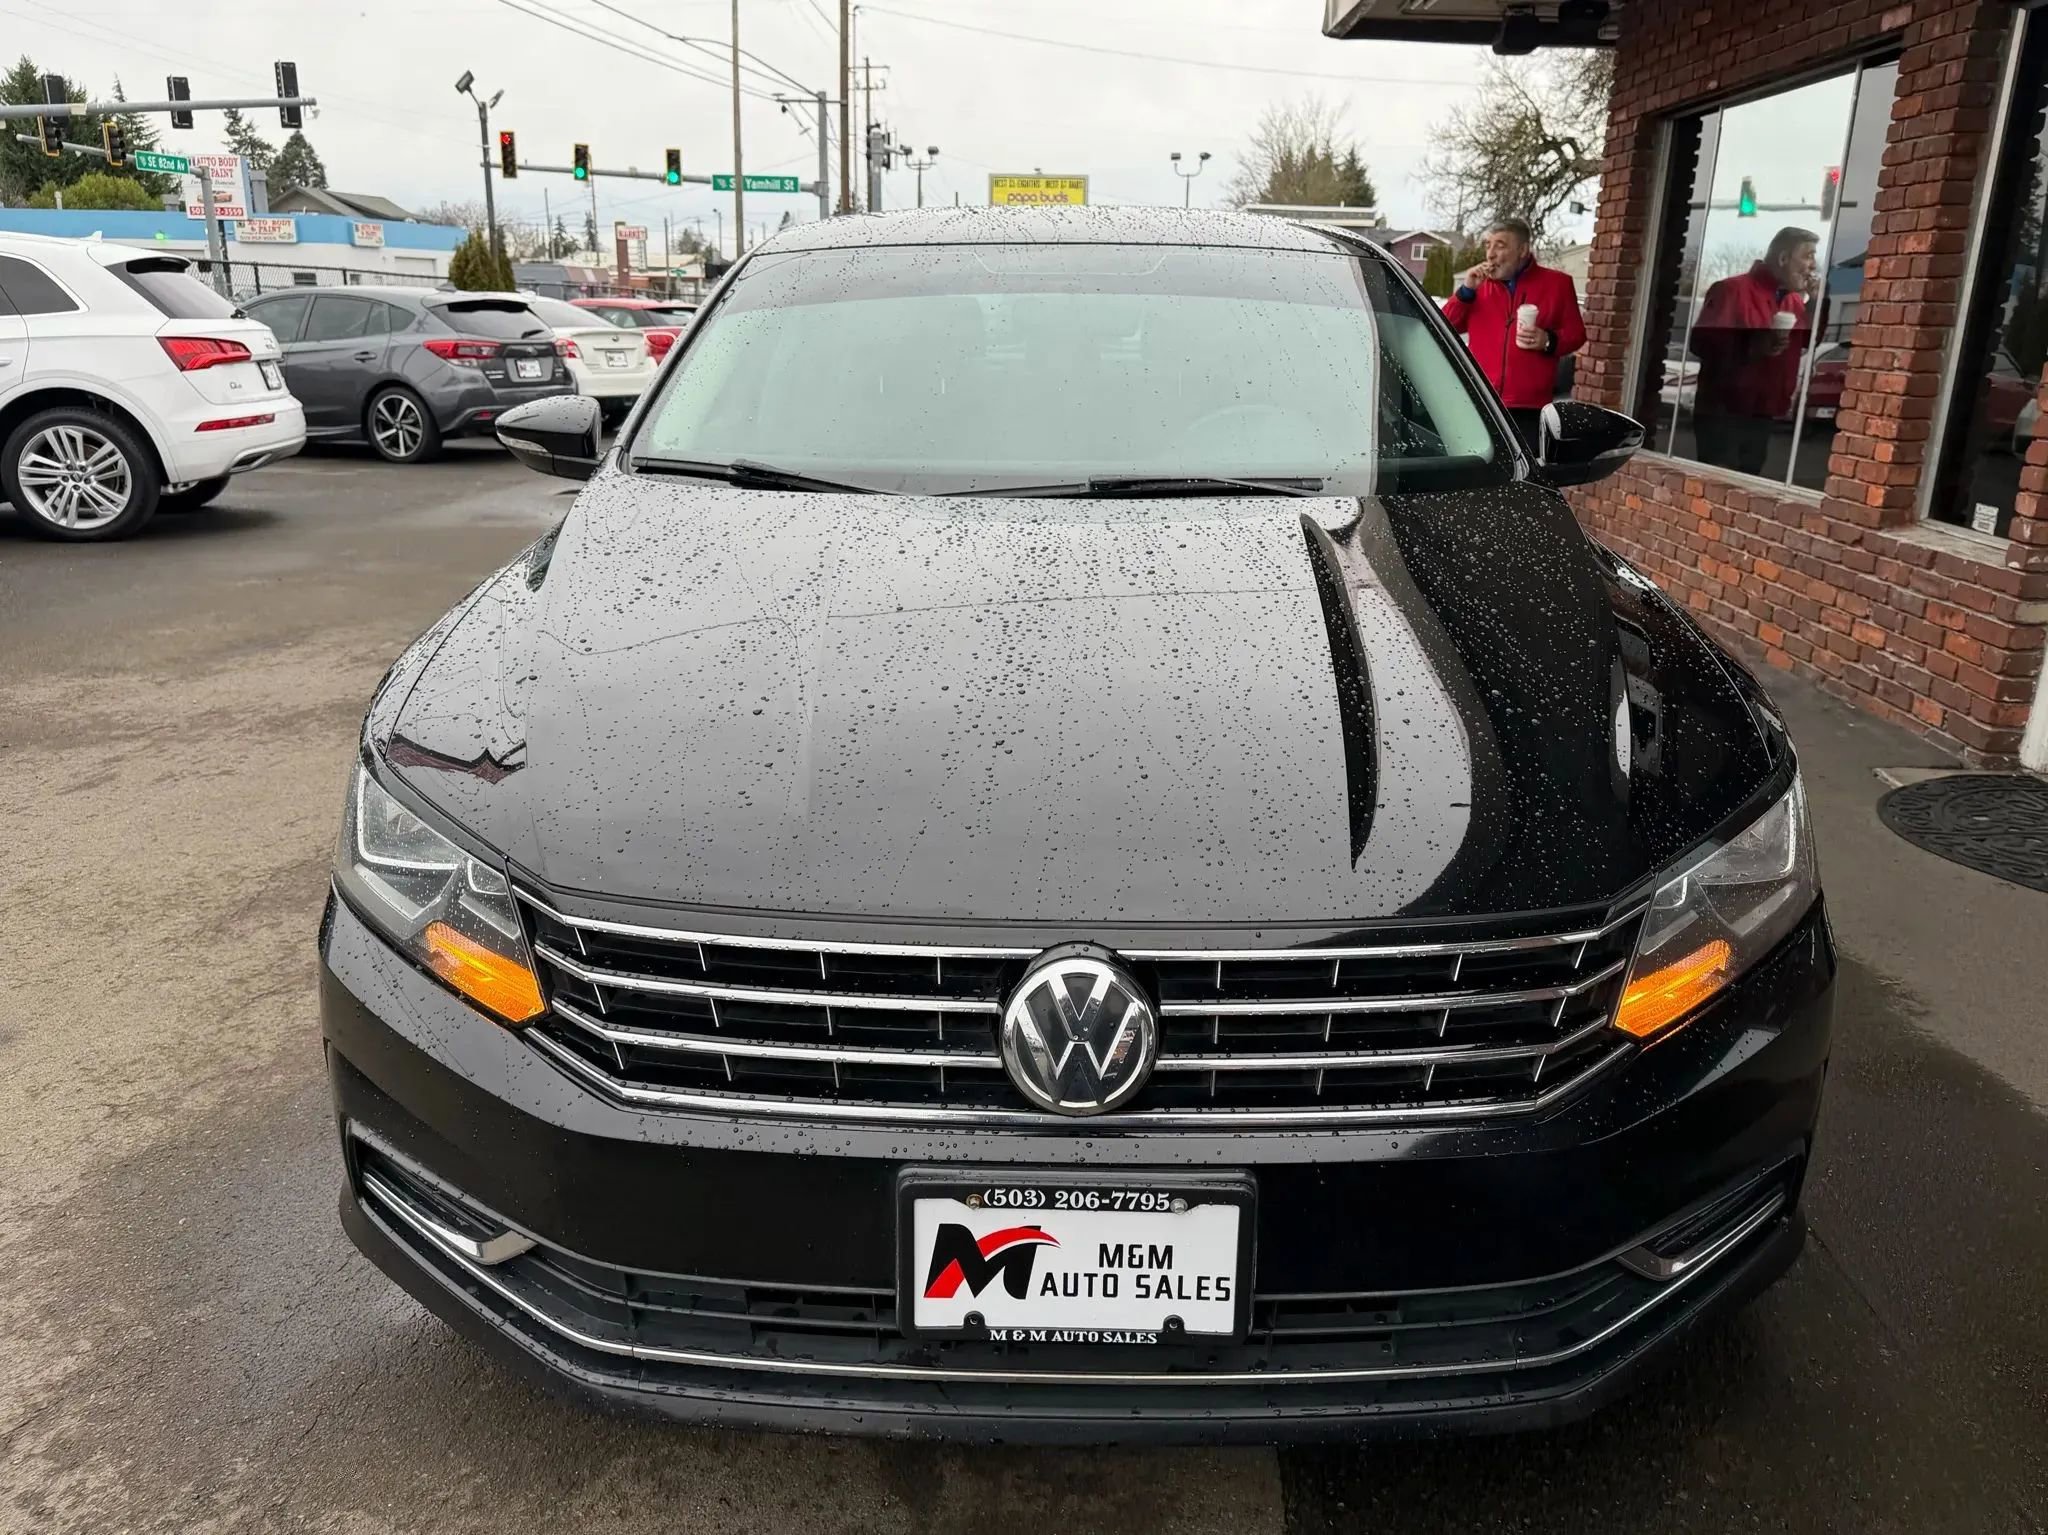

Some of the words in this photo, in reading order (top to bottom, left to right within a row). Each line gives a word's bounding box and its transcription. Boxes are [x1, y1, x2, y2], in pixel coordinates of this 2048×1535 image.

[147, 156, 157, 166] SE
[159, 157, 175, 169] 82nd
[177, 161, 185, 171] Av
[197, 156, 216, 167] AUTO
[218, 156, 239, 167] BODY
[211, 168, 233, 178] PAINT
[744, 177, 780, 190] Yamhill
[783, 179, 795, 191] St
[1007, 192, 1037, 206] papa
[1040, 191, 1069, 202] buds
[983, 1188, 1046, 1209] (503)
[1053, 1190, 1171, 1212] 206-7795
[1098, 1242, 1174, 1270] M&M
[1039, 1272, 1119, 1299] AUTO
[1134, 1274, 1232, 1302] SALES
[989, 1329, 1010, 1342] M
[1012, 1330, 1026, 1342] &
[1029, 1330, 1047, 1342] M
[1051, 1330, 1099, 1344] AUTO
[1102, 1332, 1158, 1345] SALES
